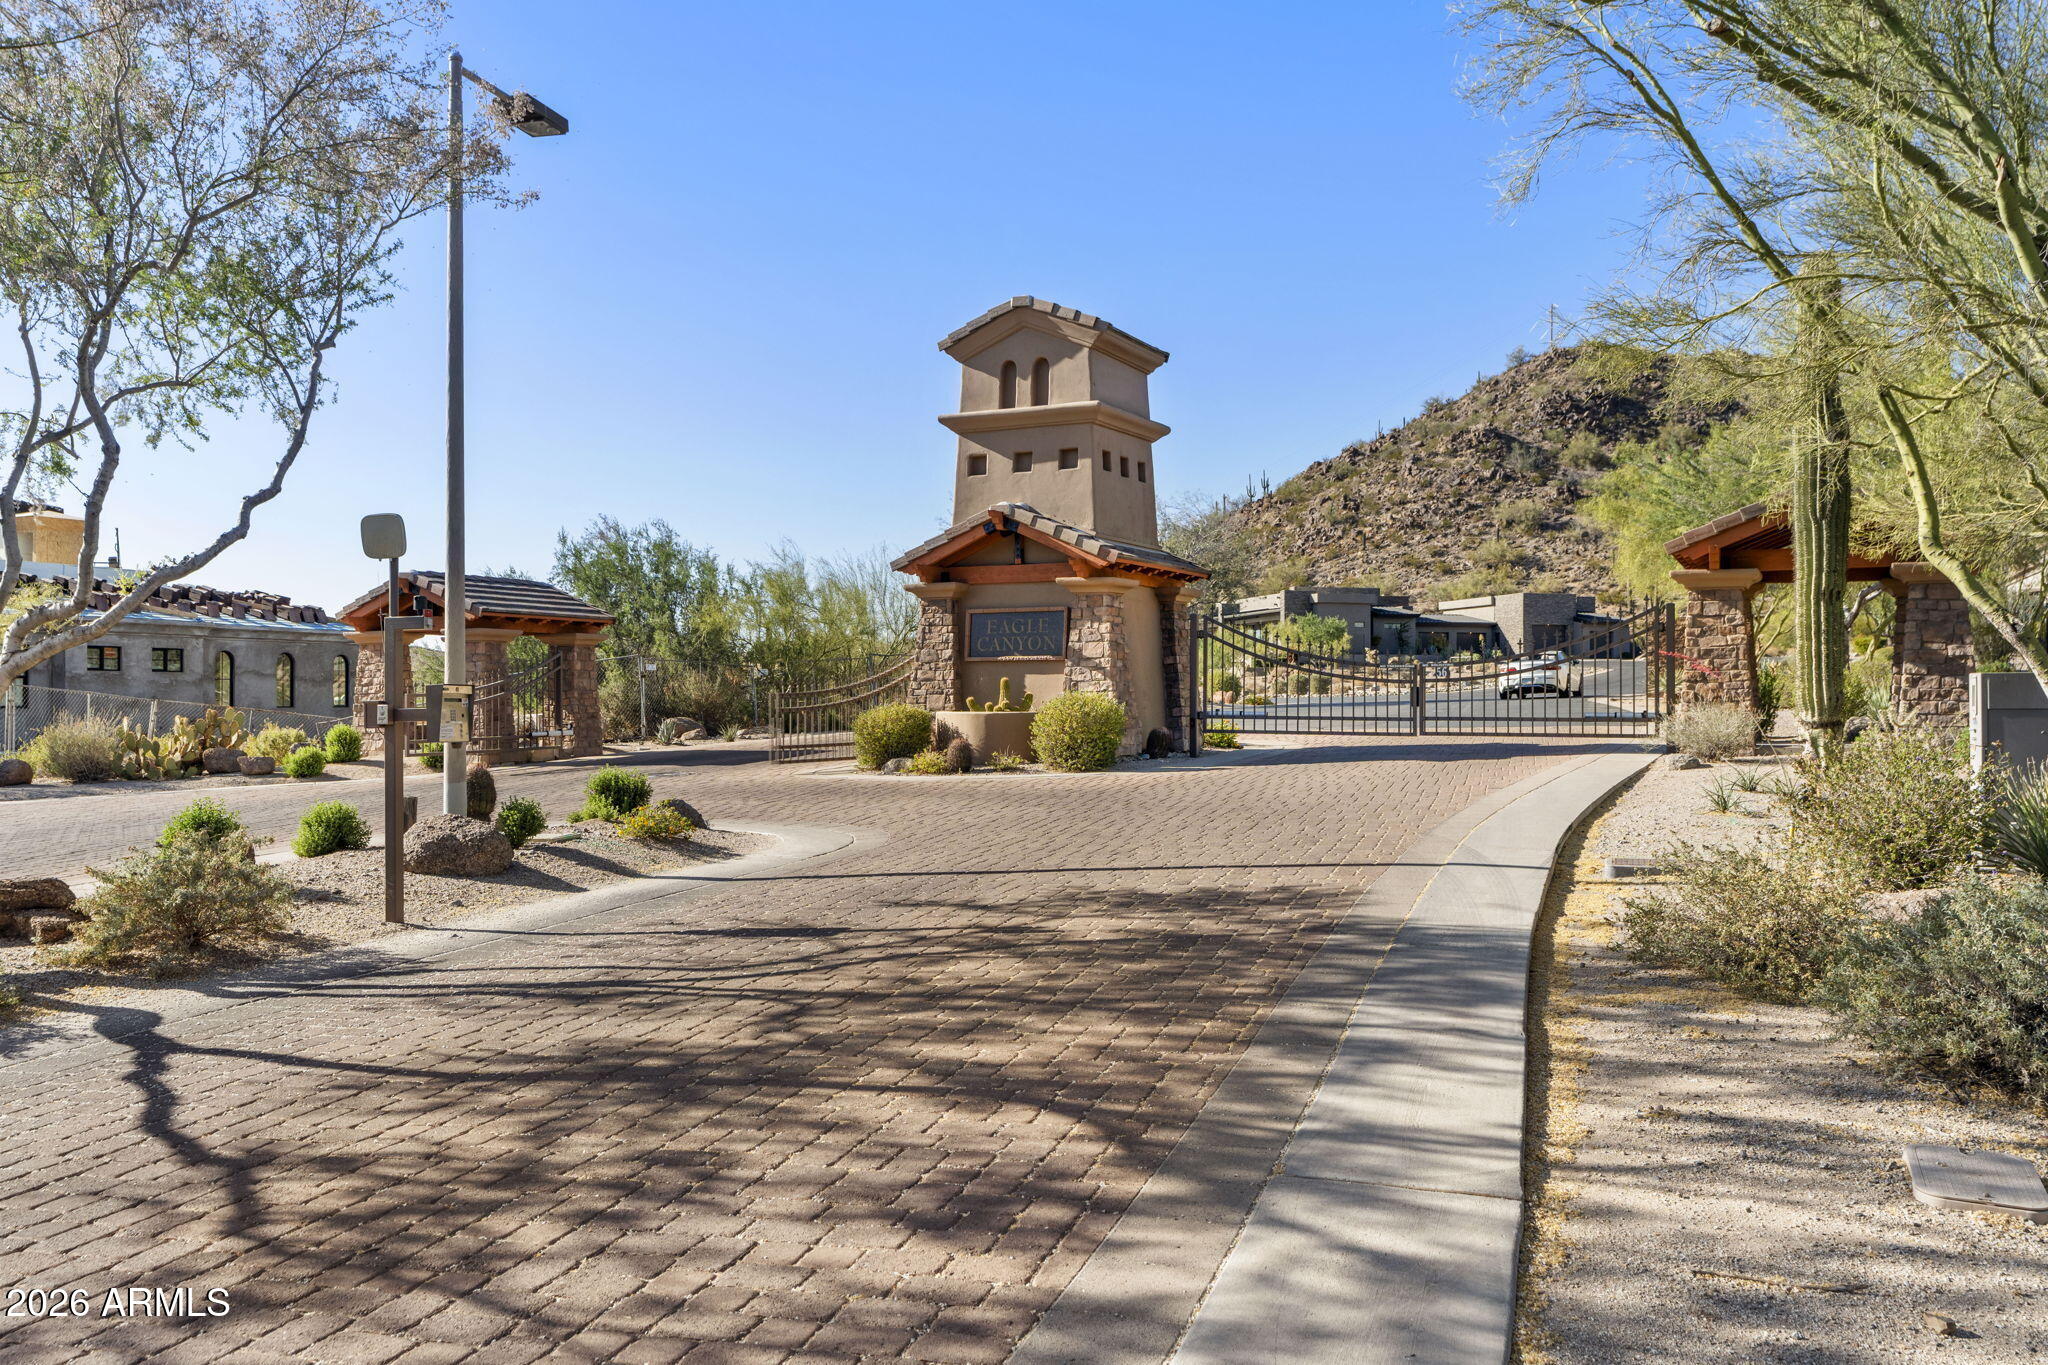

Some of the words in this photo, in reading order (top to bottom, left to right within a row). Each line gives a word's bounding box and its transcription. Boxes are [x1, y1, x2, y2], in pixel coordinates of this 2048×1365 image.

[987, 618, 1049, 634] EAGLE
[977, 636, 1056, 652] CANYON
[1436, 667, 1447, 677] 56
